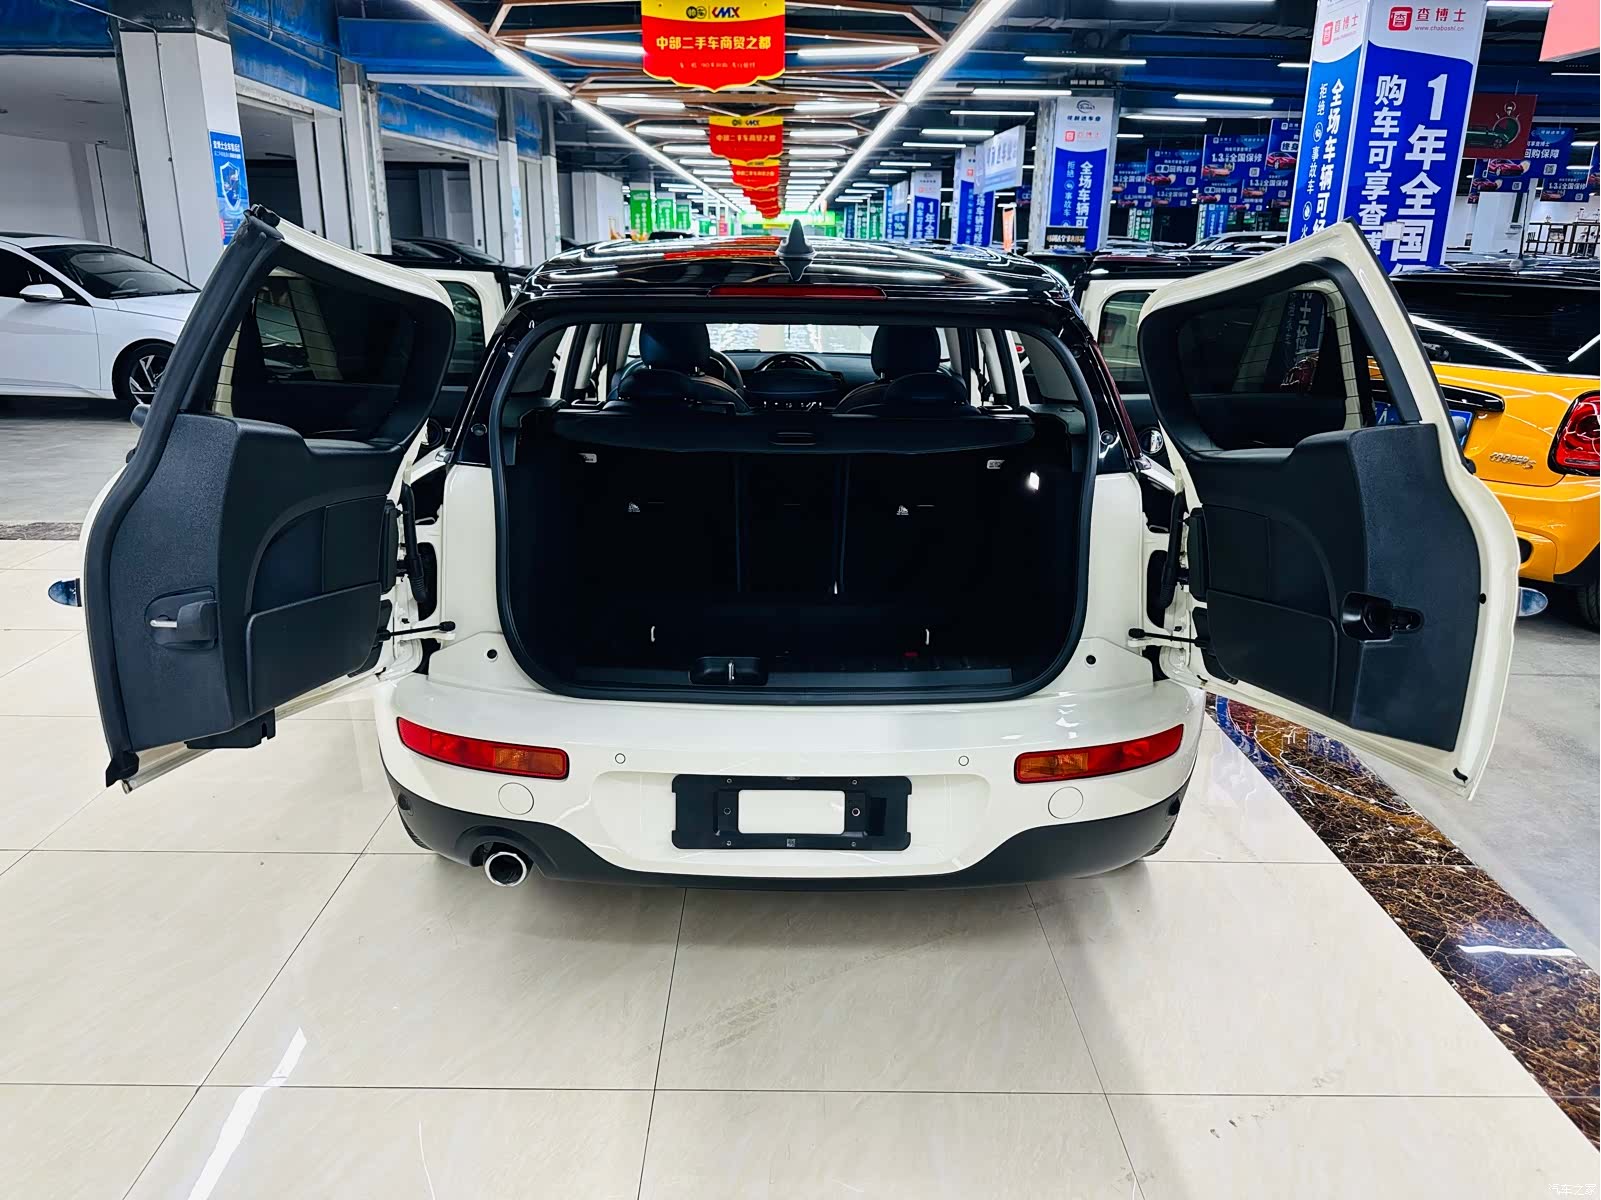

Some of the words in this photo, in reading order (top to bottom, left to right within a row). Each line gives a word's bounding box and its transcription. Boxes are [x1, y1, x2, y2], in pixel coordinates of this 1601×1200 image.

[1415, 8, 1467, 22] 查博士
[1414, 24, 1464, 32] www.chaboshi.cn
[656, 35, 772, 50] 中部二手车商贸之都
[1316, 83, 1328, 116] 拒绝
[1307, 146, 1320, 195] 事故车
